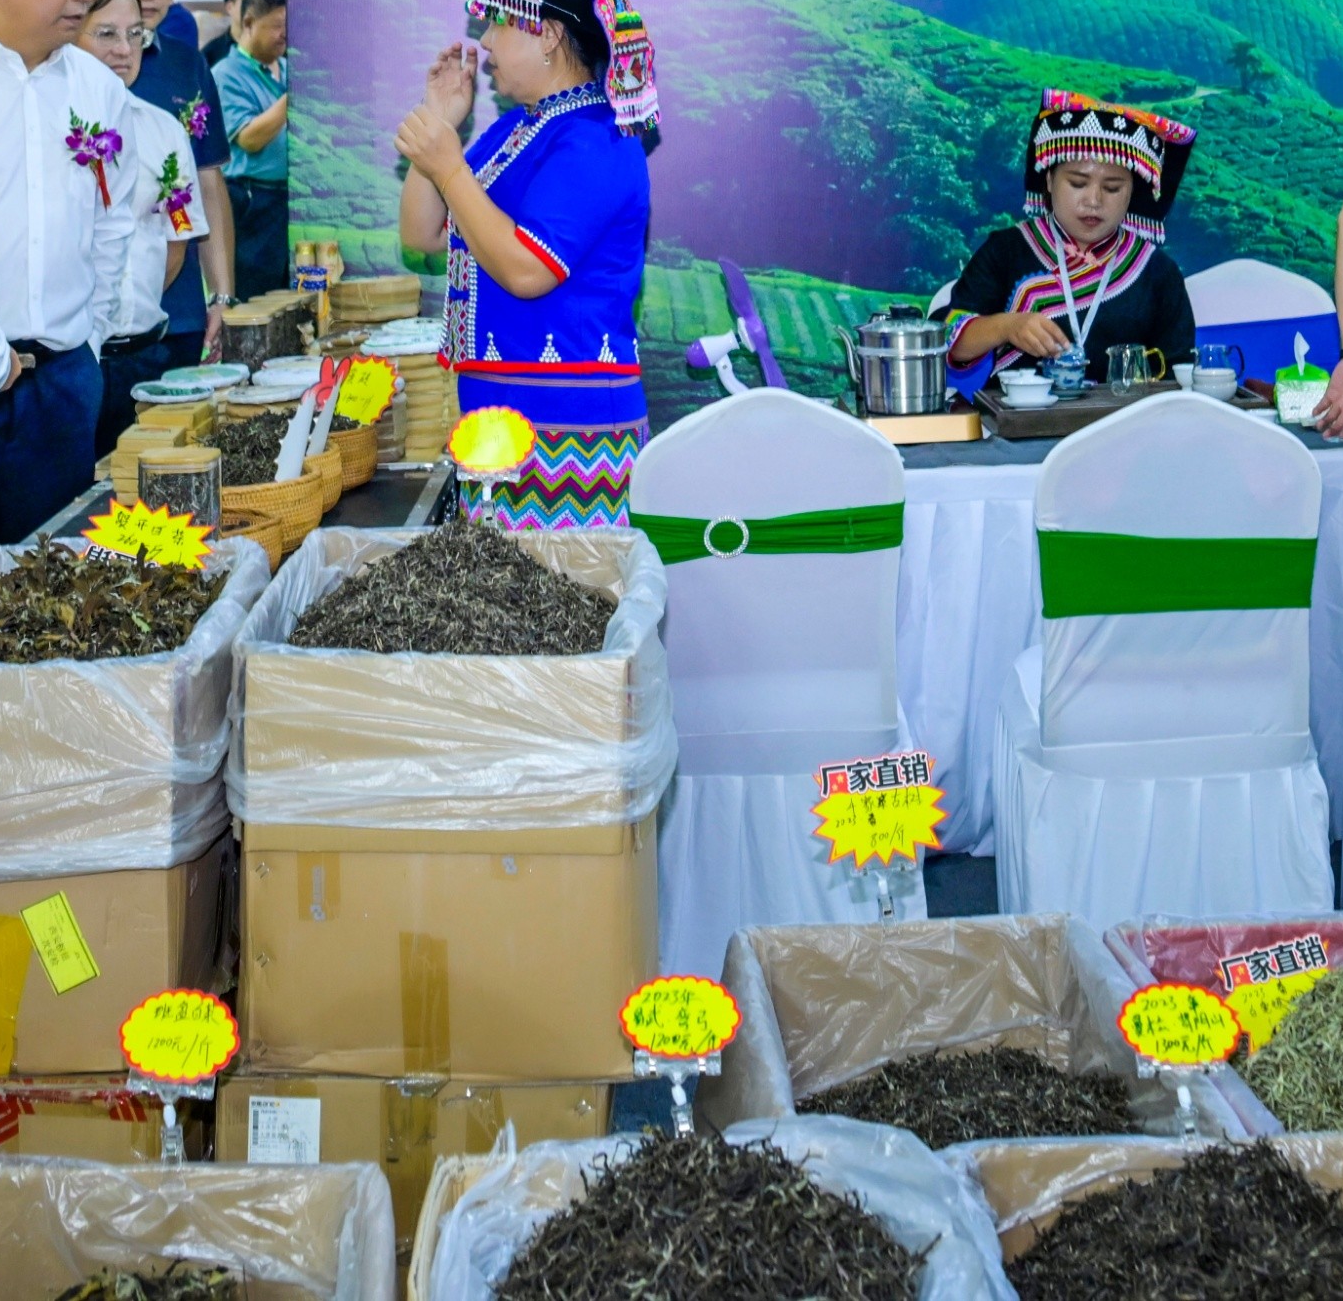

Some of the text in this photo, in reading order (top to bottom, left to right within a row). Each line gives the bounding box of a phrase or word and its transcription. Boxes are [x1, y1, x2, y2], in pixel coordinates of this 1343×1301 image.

[821, 753, 929, 795] 厂家直销
[1221, 936, 1327, 989] 厂家直销
